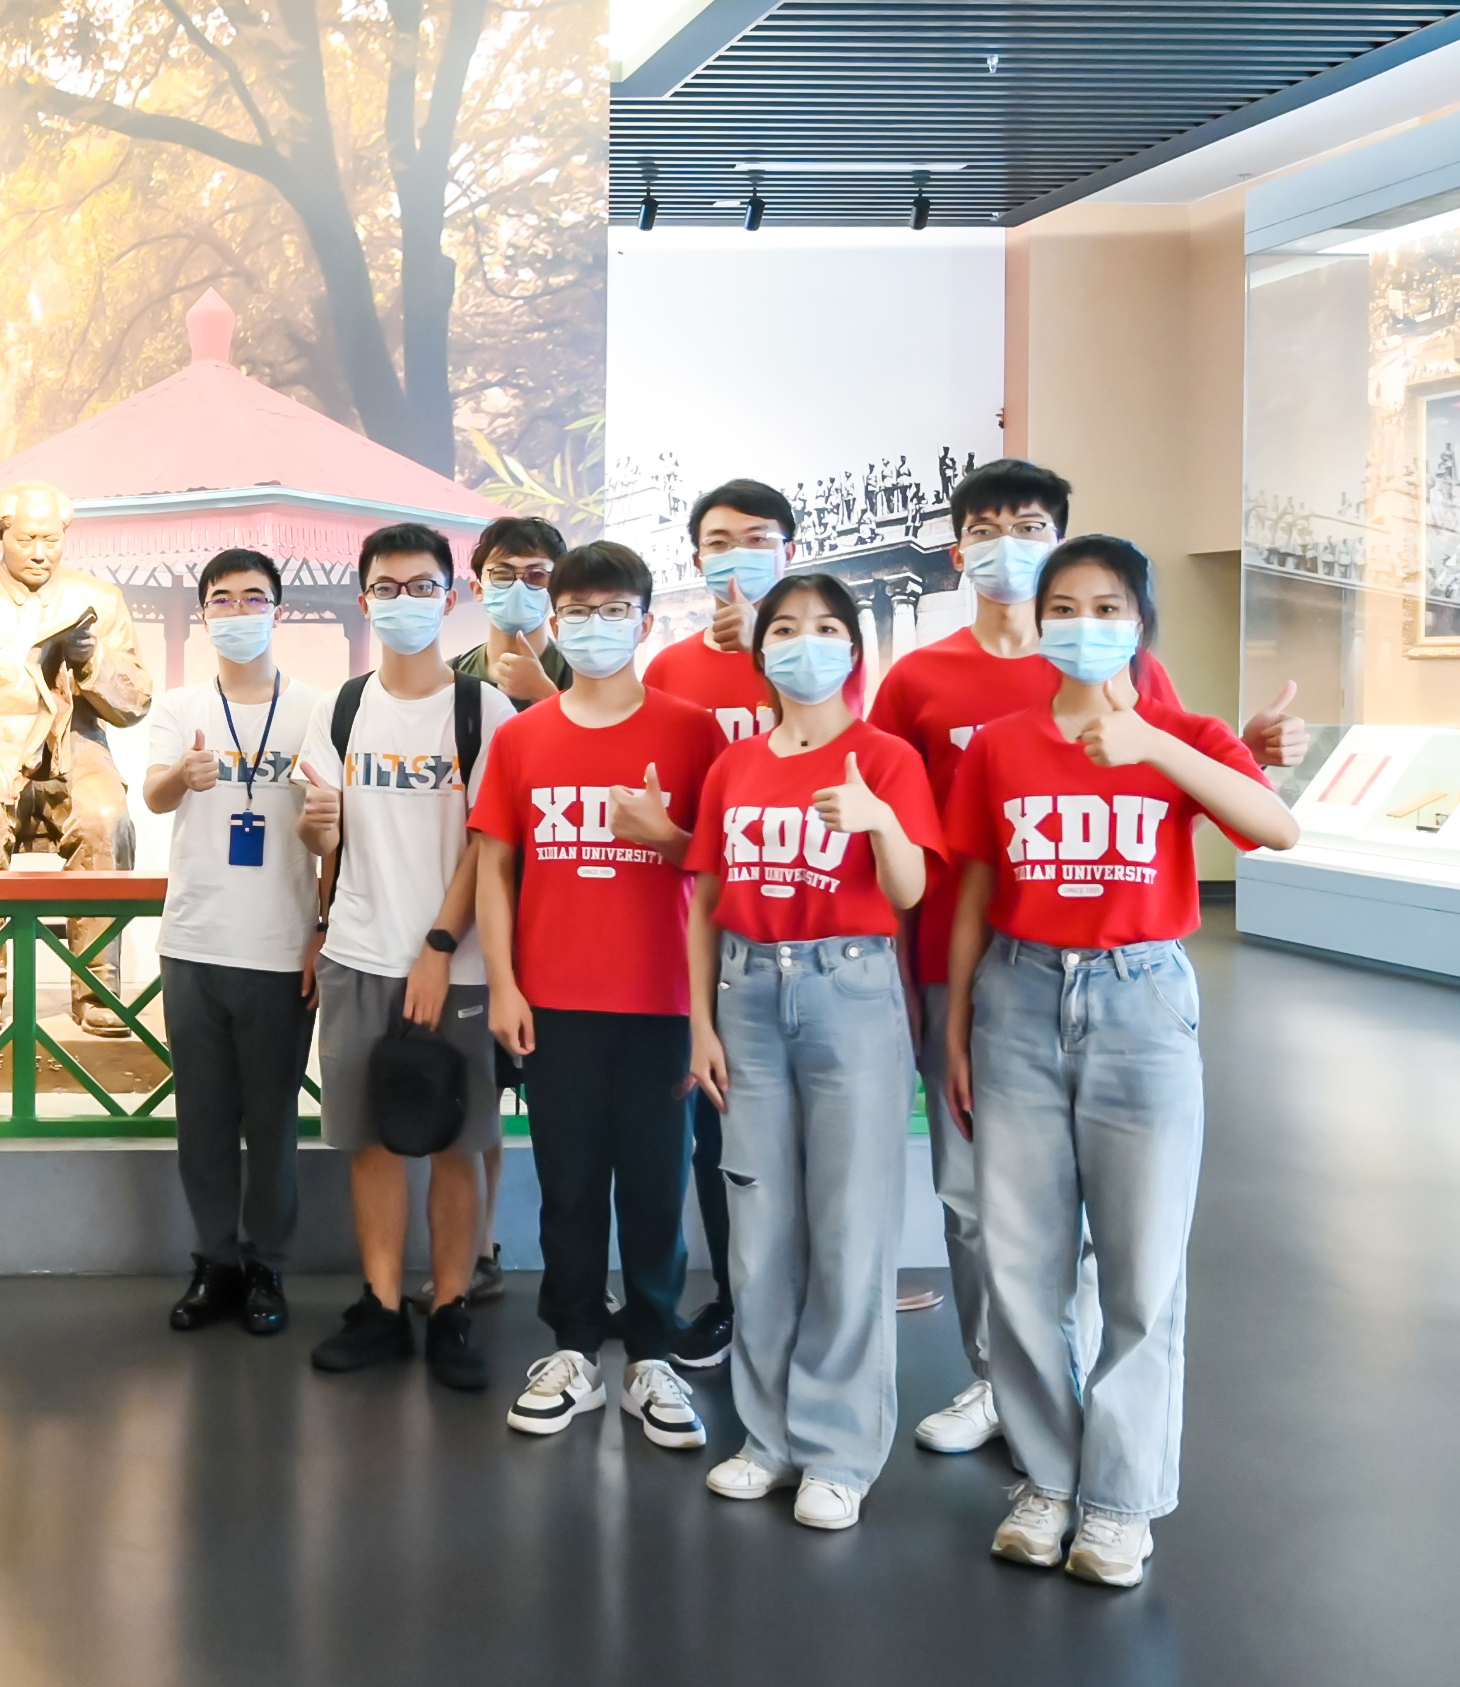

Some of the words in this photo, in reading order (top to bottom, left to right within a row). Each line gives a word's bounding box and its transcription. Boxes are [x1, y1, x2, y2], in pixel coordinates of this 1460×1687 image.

[1003, 794, 1169, 863] XDU
[536, 846, 577, 860] XIDIAN
[581, 846, 664, 865] UNIVERSITY
